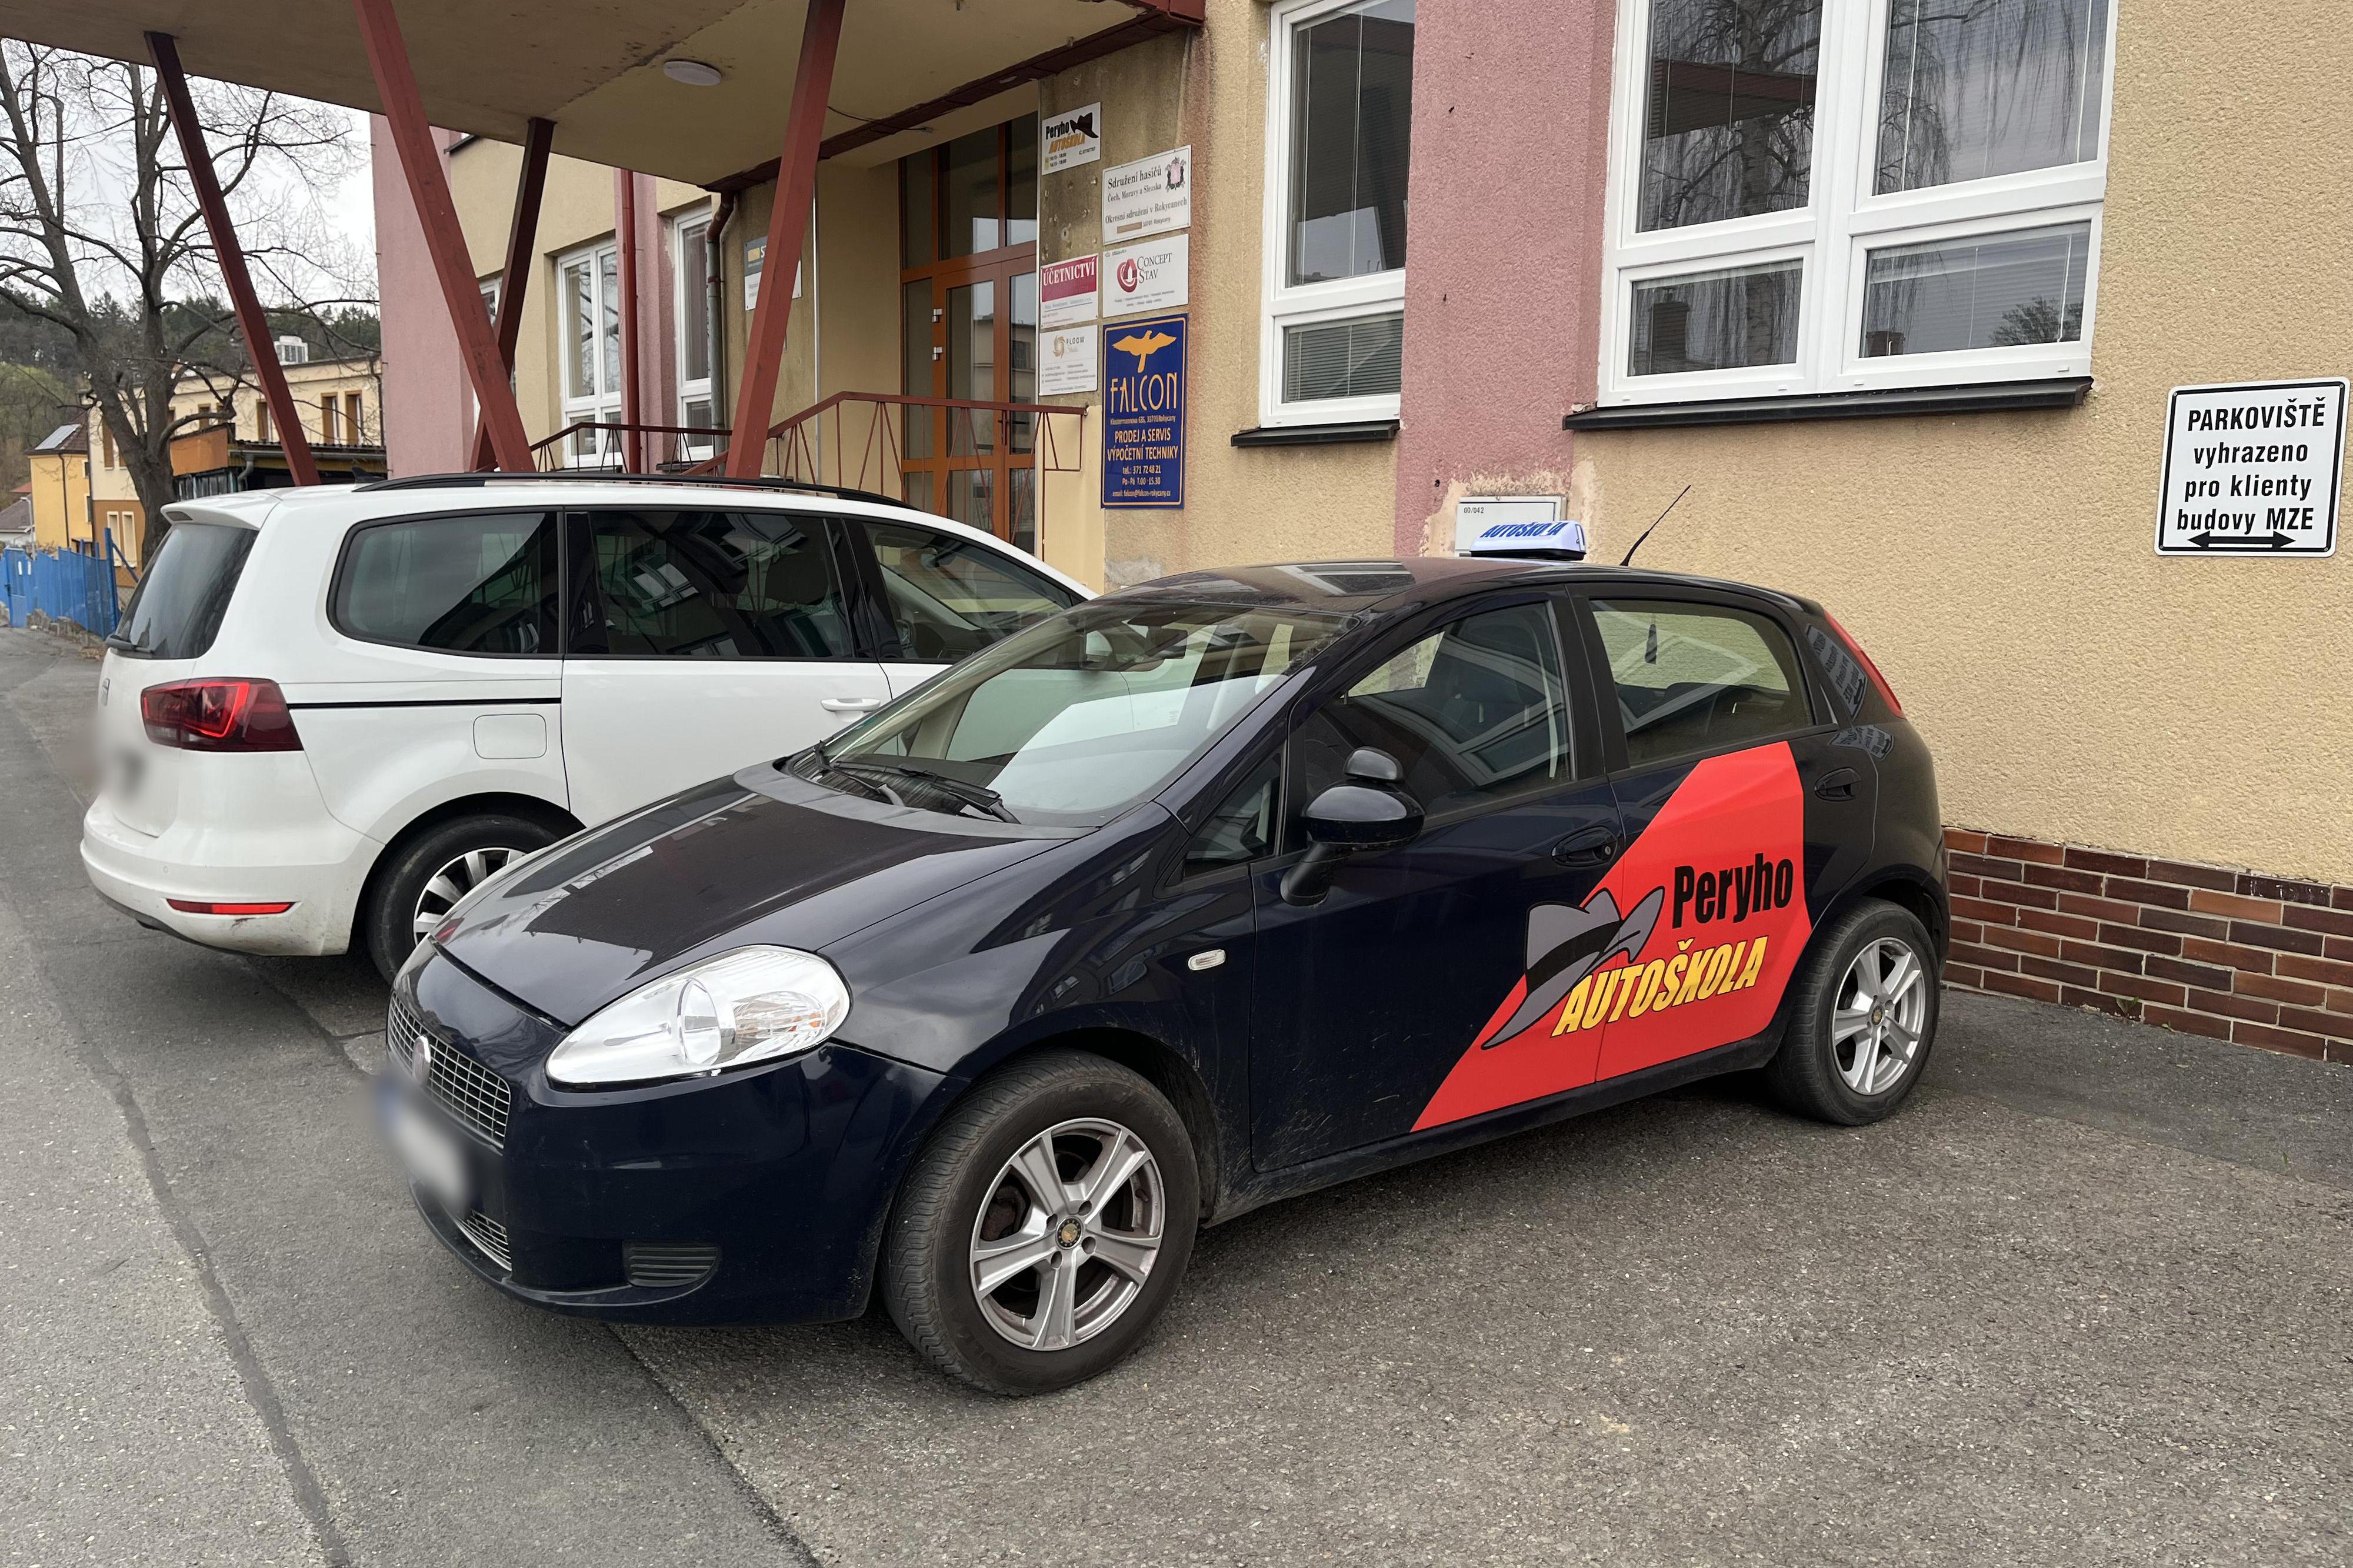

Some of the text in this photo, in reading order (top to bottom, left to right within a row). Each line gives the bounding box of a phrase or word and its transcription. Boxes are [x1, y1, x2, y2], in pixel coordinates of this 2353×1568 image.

[1046, 121, 1069, 139] Peryho
[1108, 165, 1162, 189] Sdružení hasičů
[1121, 189, 1138, 200] Moravy
[1143, 182, 1161, 193] Slezska
[1105, 211, 1125, 224] Okresní
[1126, 205, 1148, 219] sdružení
[1155, 196, 1187, 212] Rokycanech
[1043, 258, 1095, 286] ÚČETNICTVÍ
[1110, 372, 1177, 413] FALCON
[2188, 397, 2326, 431] PARKOVIŠTĚ
[1115, 428, 1171, 443] PRODEJ A SERVIS
[1107, 444, 1178, 461] VÝPOČETNÍ TECHNIKY
[2194, 442, 2308, 469] vyhrazeno
[1132, 465, 1141, 474] 371
[1155, 465, 1161, 473] 21
[2184, 475, 2312, 502] pro klienty
[2177, 508, 2314, 535] budovy MZE
[1671, 852, 1794, 929] Peryho
[1550, 935, 1769, 1038] AUTOŠKOLA
